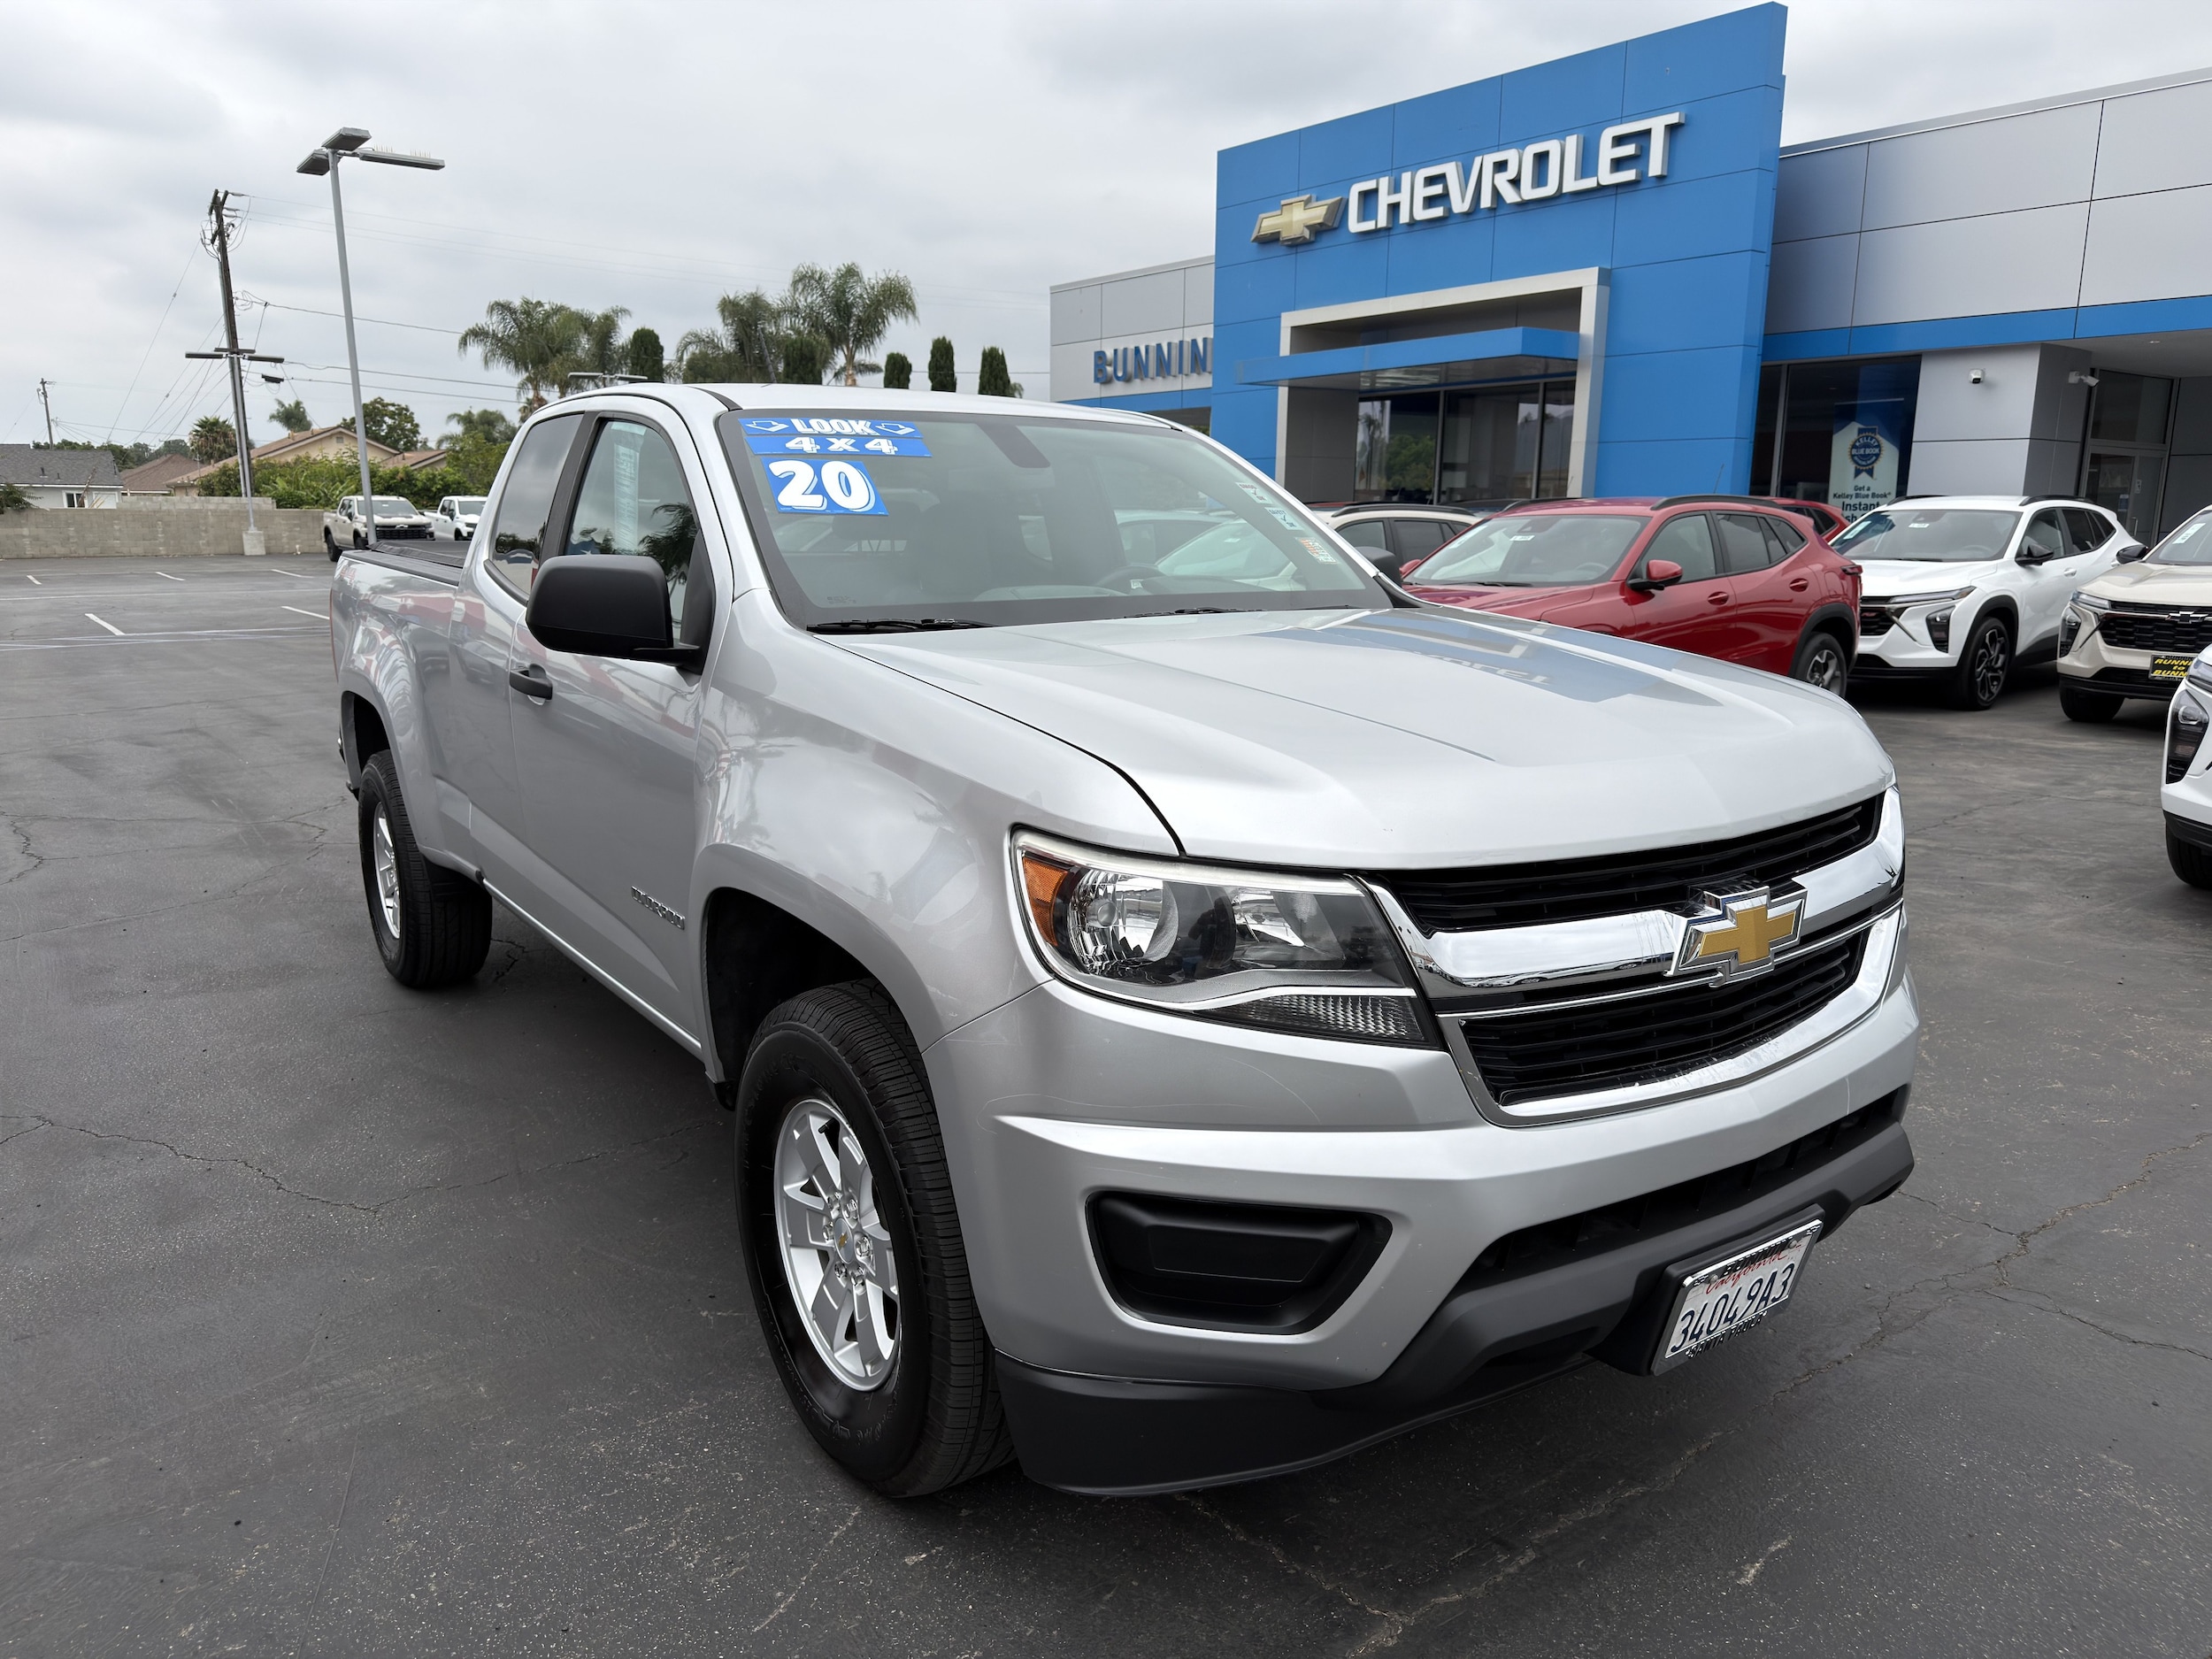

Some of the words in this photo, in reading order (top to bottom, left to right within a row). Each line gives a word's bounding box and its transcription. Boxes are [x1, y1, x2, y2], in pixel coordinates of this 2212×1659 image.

[1348, 111, 1685, 234] CHEVROLET
[1094, 337, 1213, 384] BUNNIN
[790, 419, 880, 435] LOOK
[1855, 436, 1878, 446] KELLEY
[769, 460, 876, 511] 20
[1842, 501, 1879, 511] Instant
